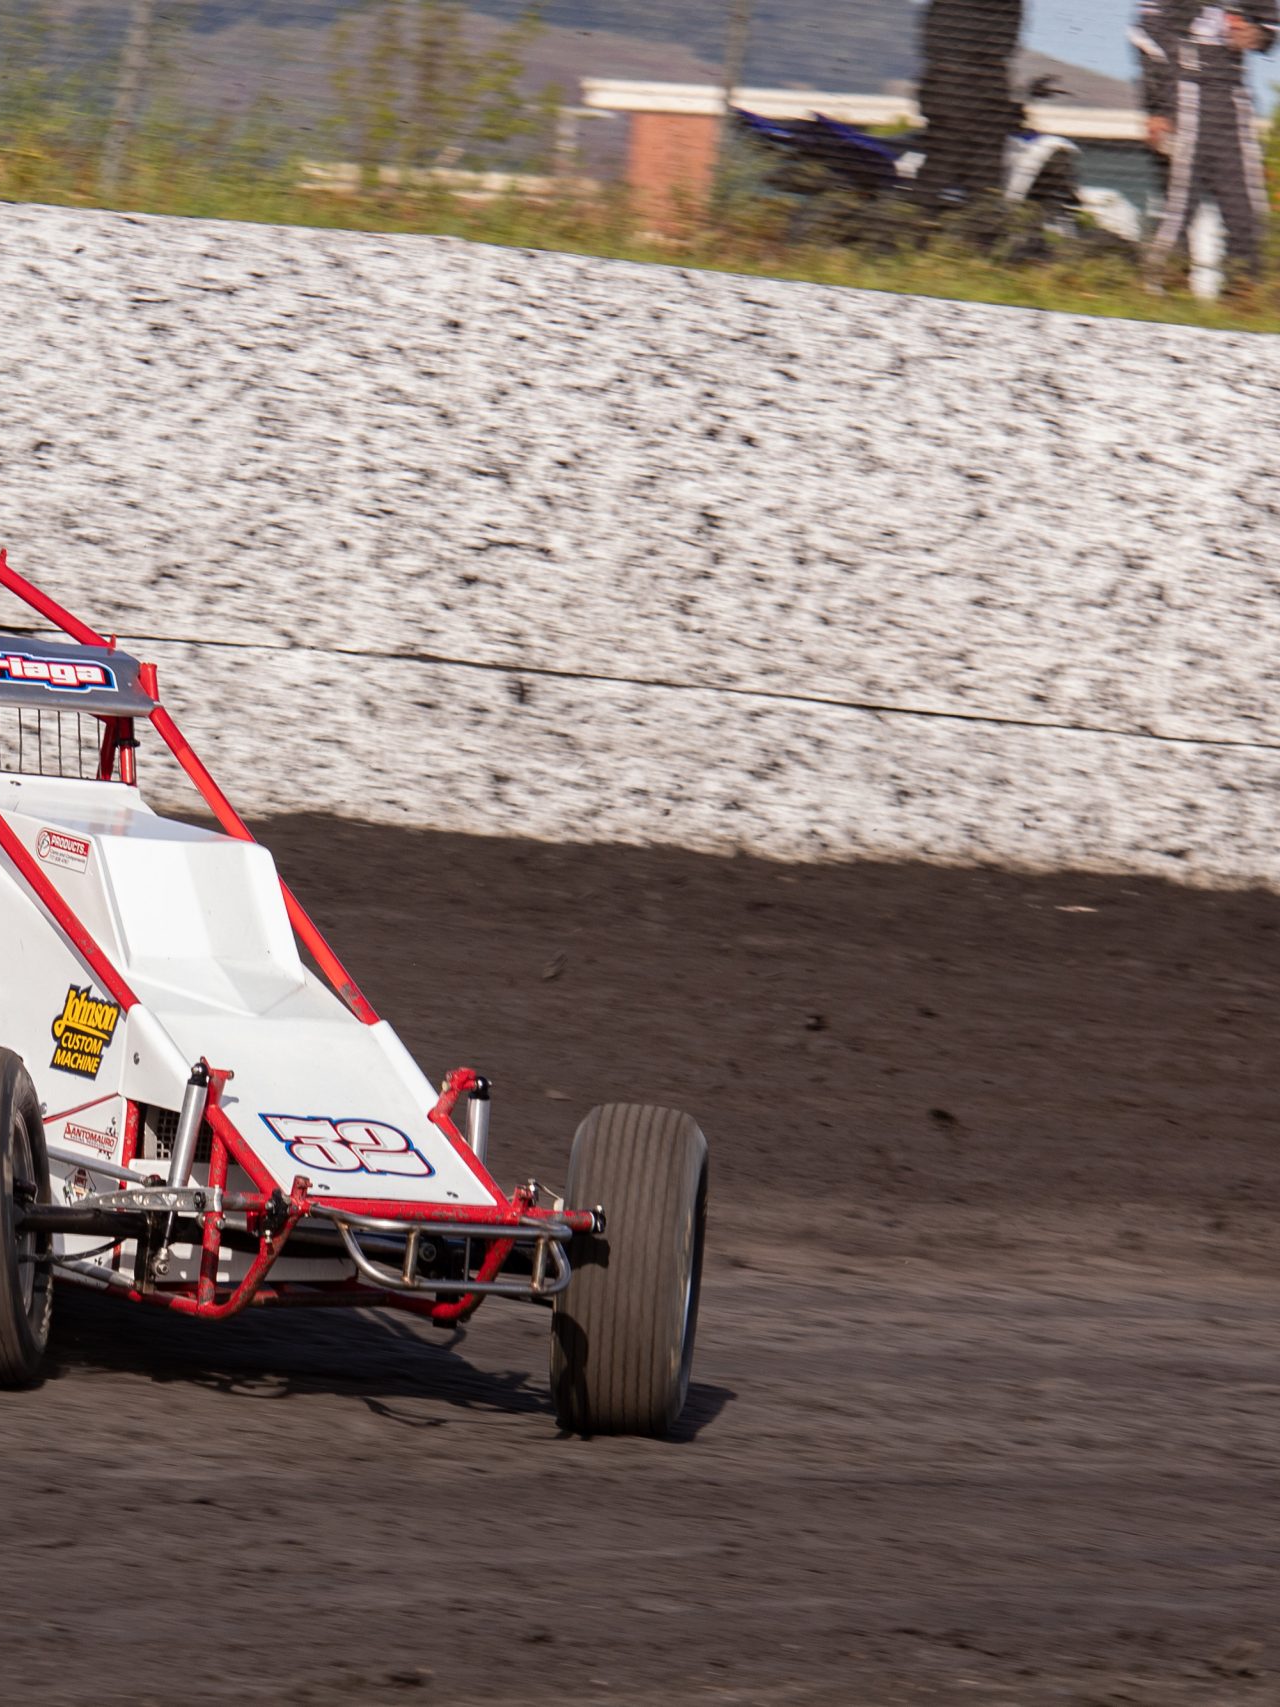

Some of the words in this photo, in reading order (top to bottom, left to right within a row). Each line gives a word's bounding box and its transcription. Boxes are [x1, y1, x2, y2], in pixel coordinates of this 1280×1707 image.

[51, 834, 86, 855] PRODUCTS
[53, 989, 119, 1038] Johnson
[61, 1031, 103, 1056] CUSTOM
[53, 1048, 101, 1074] MACHINE
[65, 1122, 115, 1148] SANTOMAURO
[258, 1112, 437, 1178] 52
